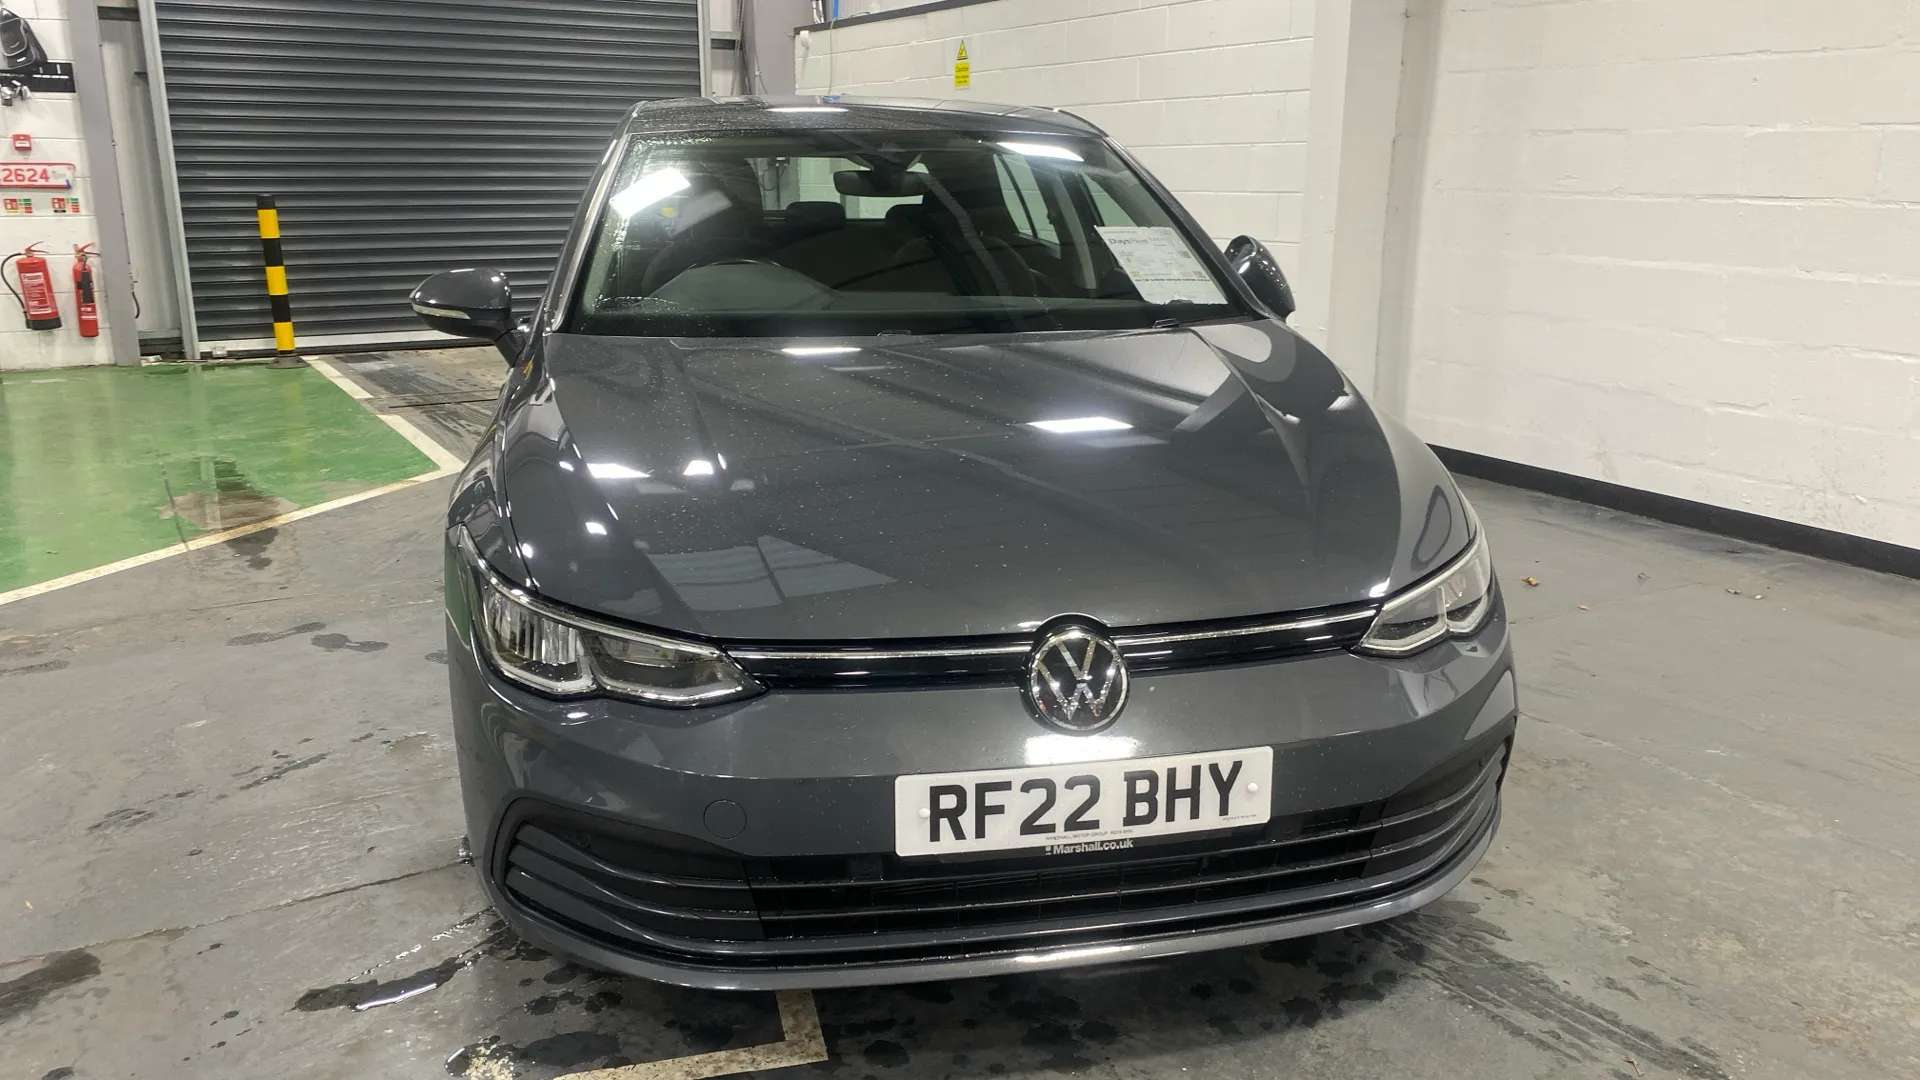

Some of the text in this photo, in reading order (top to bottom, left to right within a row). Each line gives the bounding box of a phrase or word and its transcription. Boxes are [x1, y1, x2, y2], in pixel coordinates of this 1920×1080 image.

[0, 168, 50, 182] 2624
[929, 760, 1243, 842] RF22 BHY
[1053, 839, 1134, 855] Marshall.co.uk
